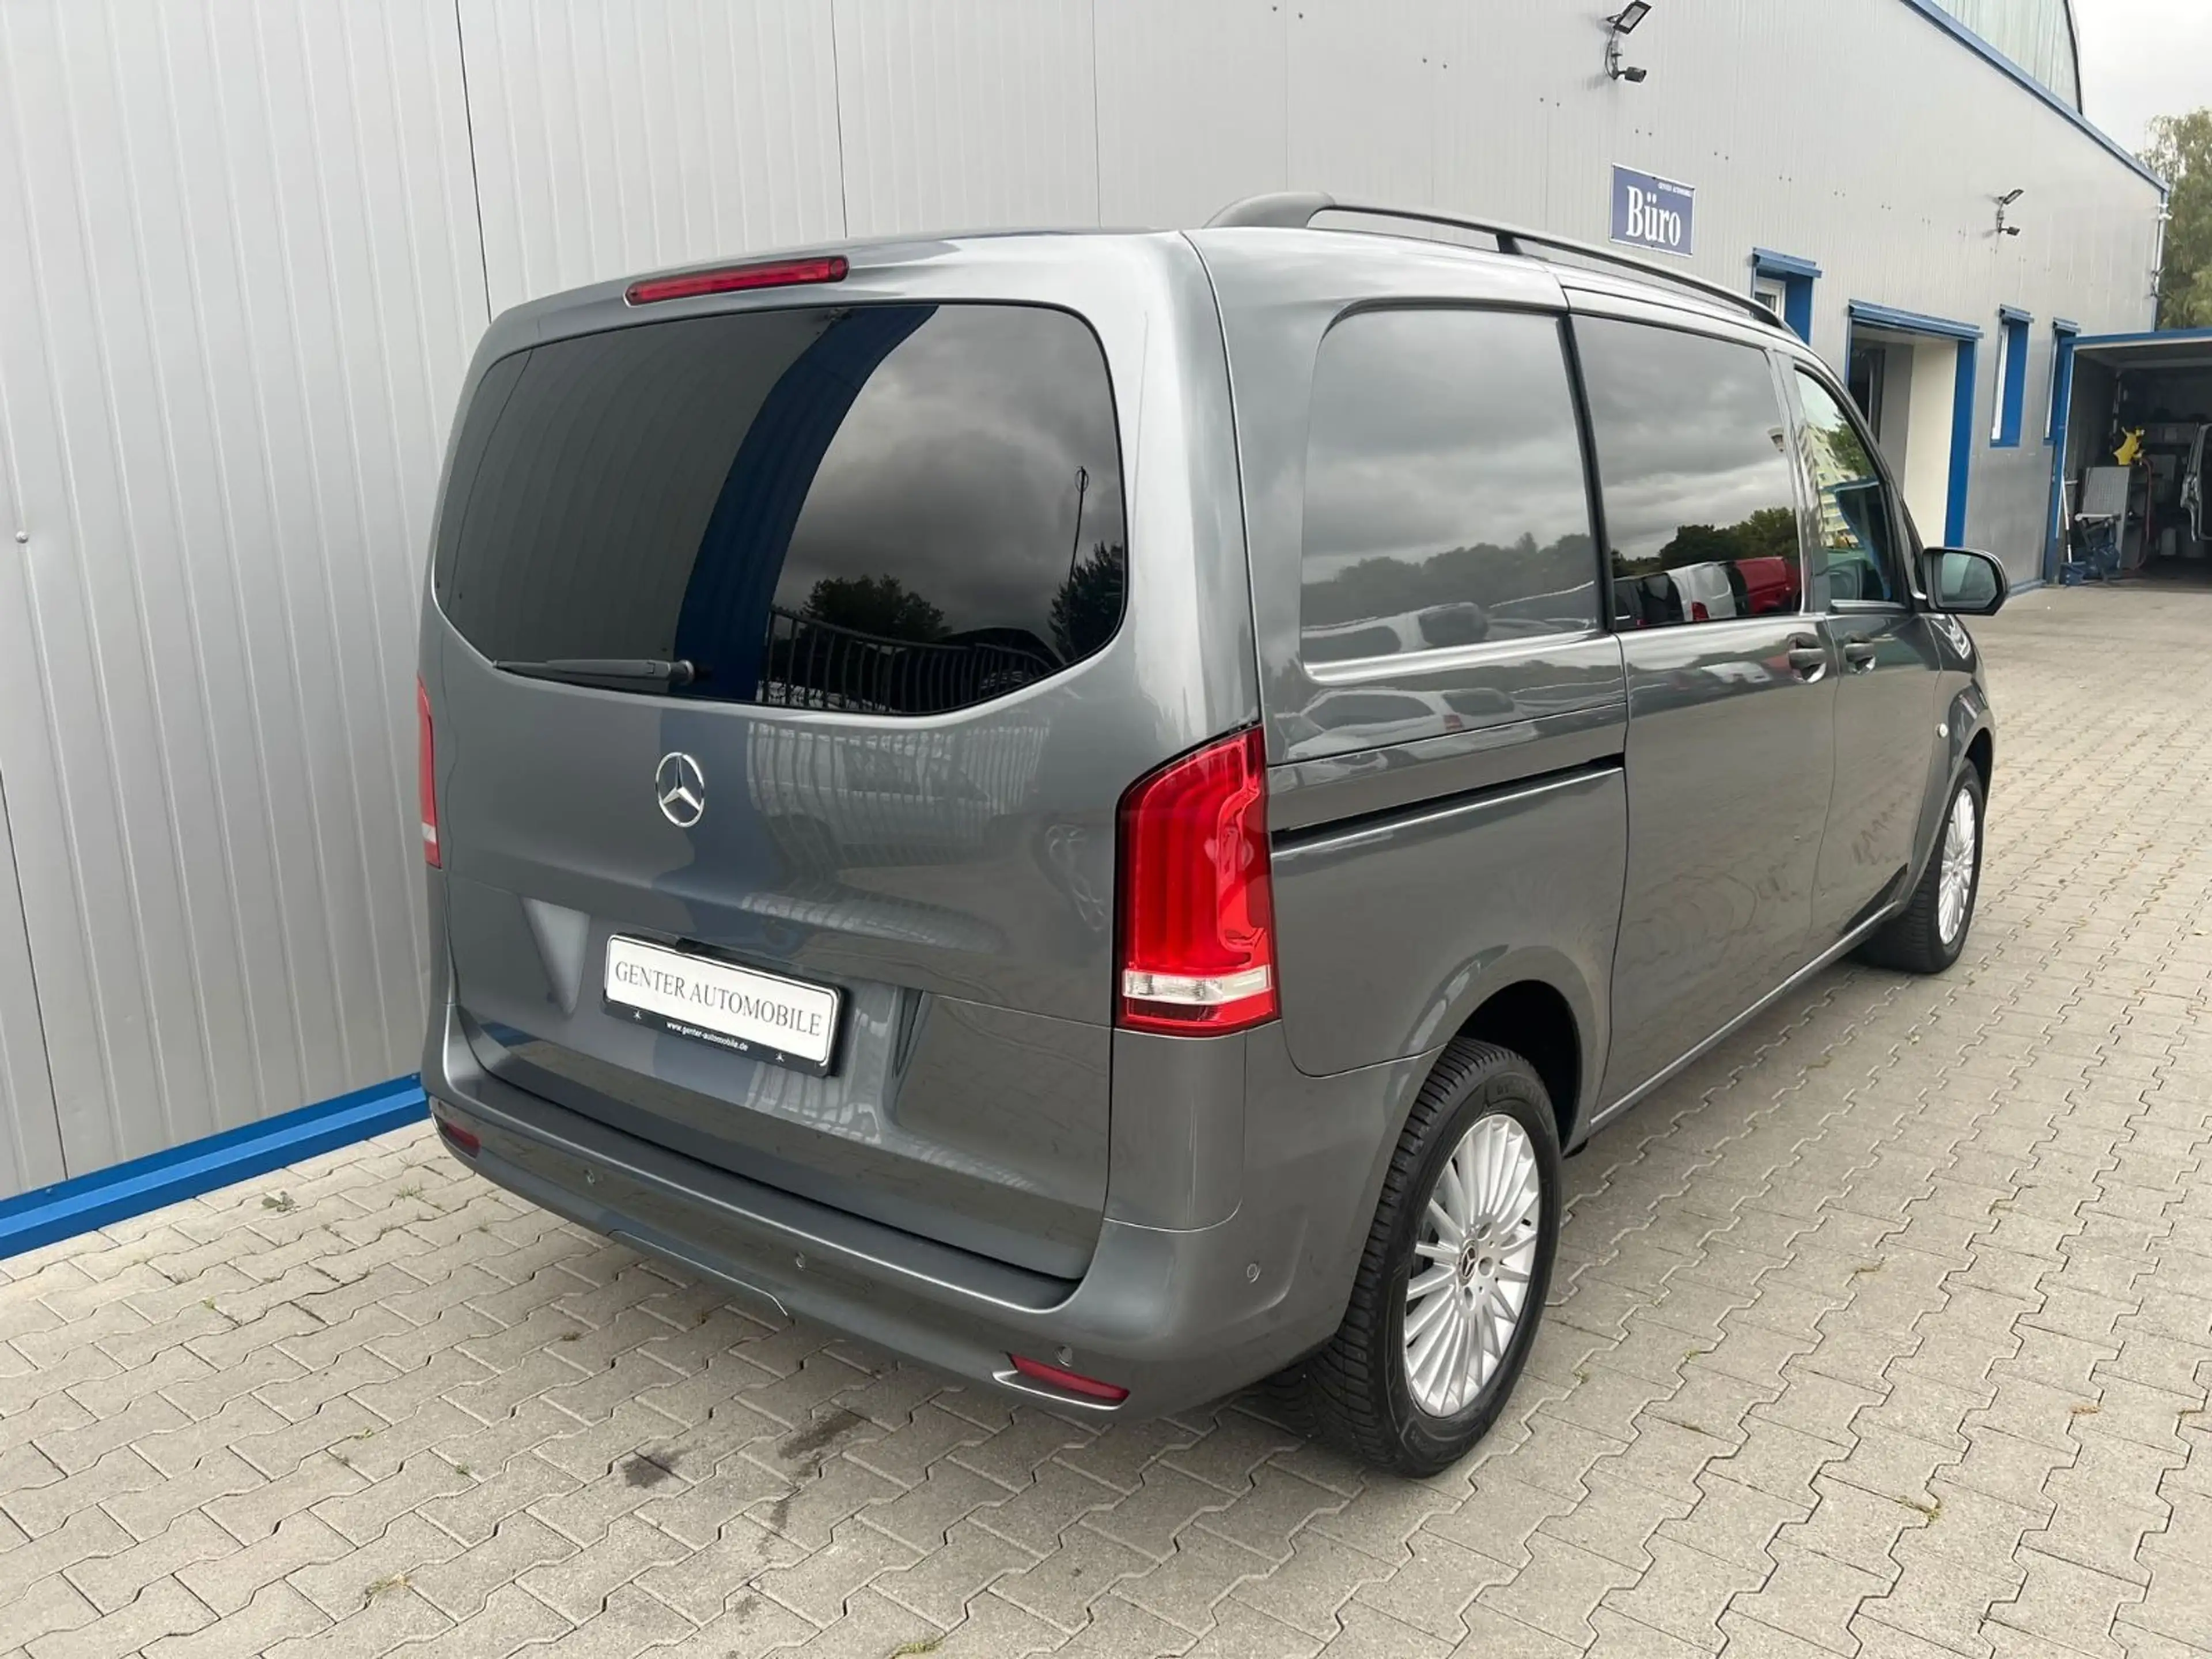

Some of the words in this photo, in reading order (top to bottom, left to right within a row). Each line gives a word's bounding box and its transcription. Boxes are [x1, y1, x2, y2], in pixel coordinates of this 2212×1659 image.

[1626, 185, 1681, 247] Büro
[615, 960, 685, 999] GENTER
[690, 982, 822, 1037] AUTOMOBILE
[666, 1021, 749, 1052] www.genter-automobile.de
